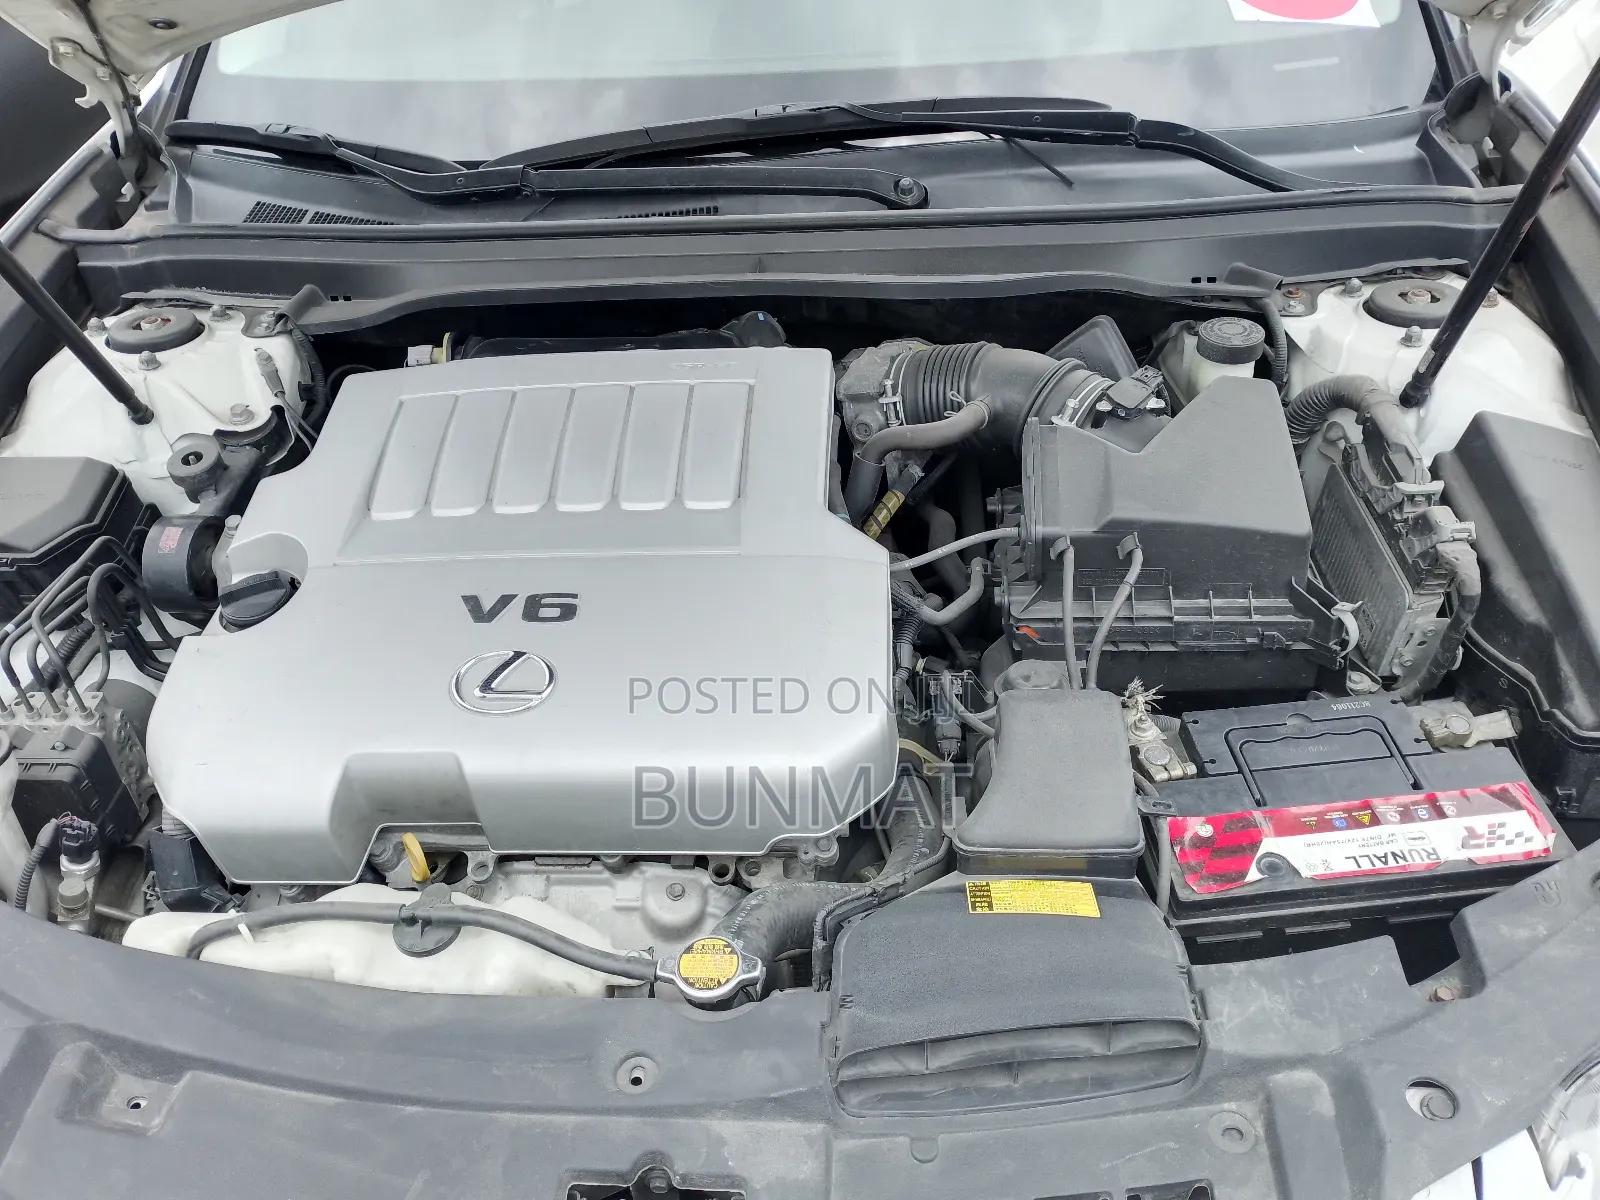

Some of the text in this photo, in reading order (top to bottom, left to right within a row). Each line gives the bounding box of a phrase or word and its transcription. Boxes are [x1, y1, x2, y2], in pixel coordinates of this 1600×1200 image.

[461, 592, 579, 623] V6
[1358, 838, 1398, 848] CAR BATTERY
[1345, 847, 1441, 869] RUNALL
